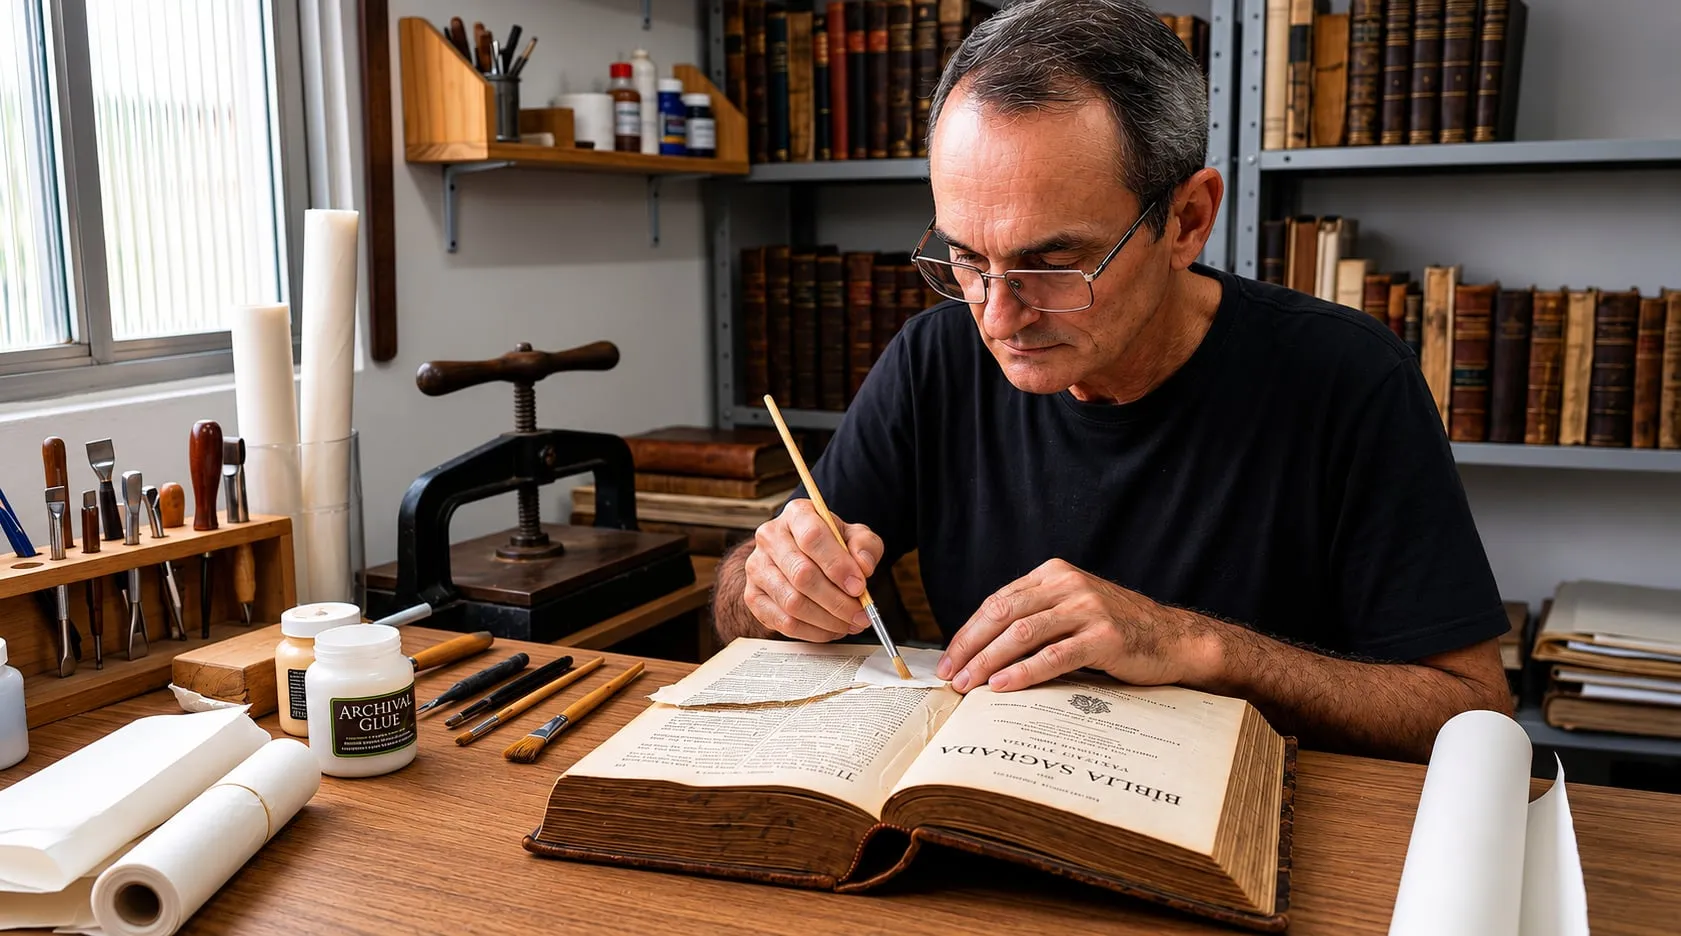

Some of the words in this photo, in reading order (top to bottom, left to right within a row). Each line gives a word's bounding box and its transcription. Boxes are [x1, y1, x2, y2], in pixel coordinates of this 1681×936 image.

[339, 694, 412, 720] ARCHIVAL
[359, 712, 401, 731] GLUE
[941, 745, 1076, 777] SAGRADA
[1088, 770, 1182, 807] BÍBLIA
